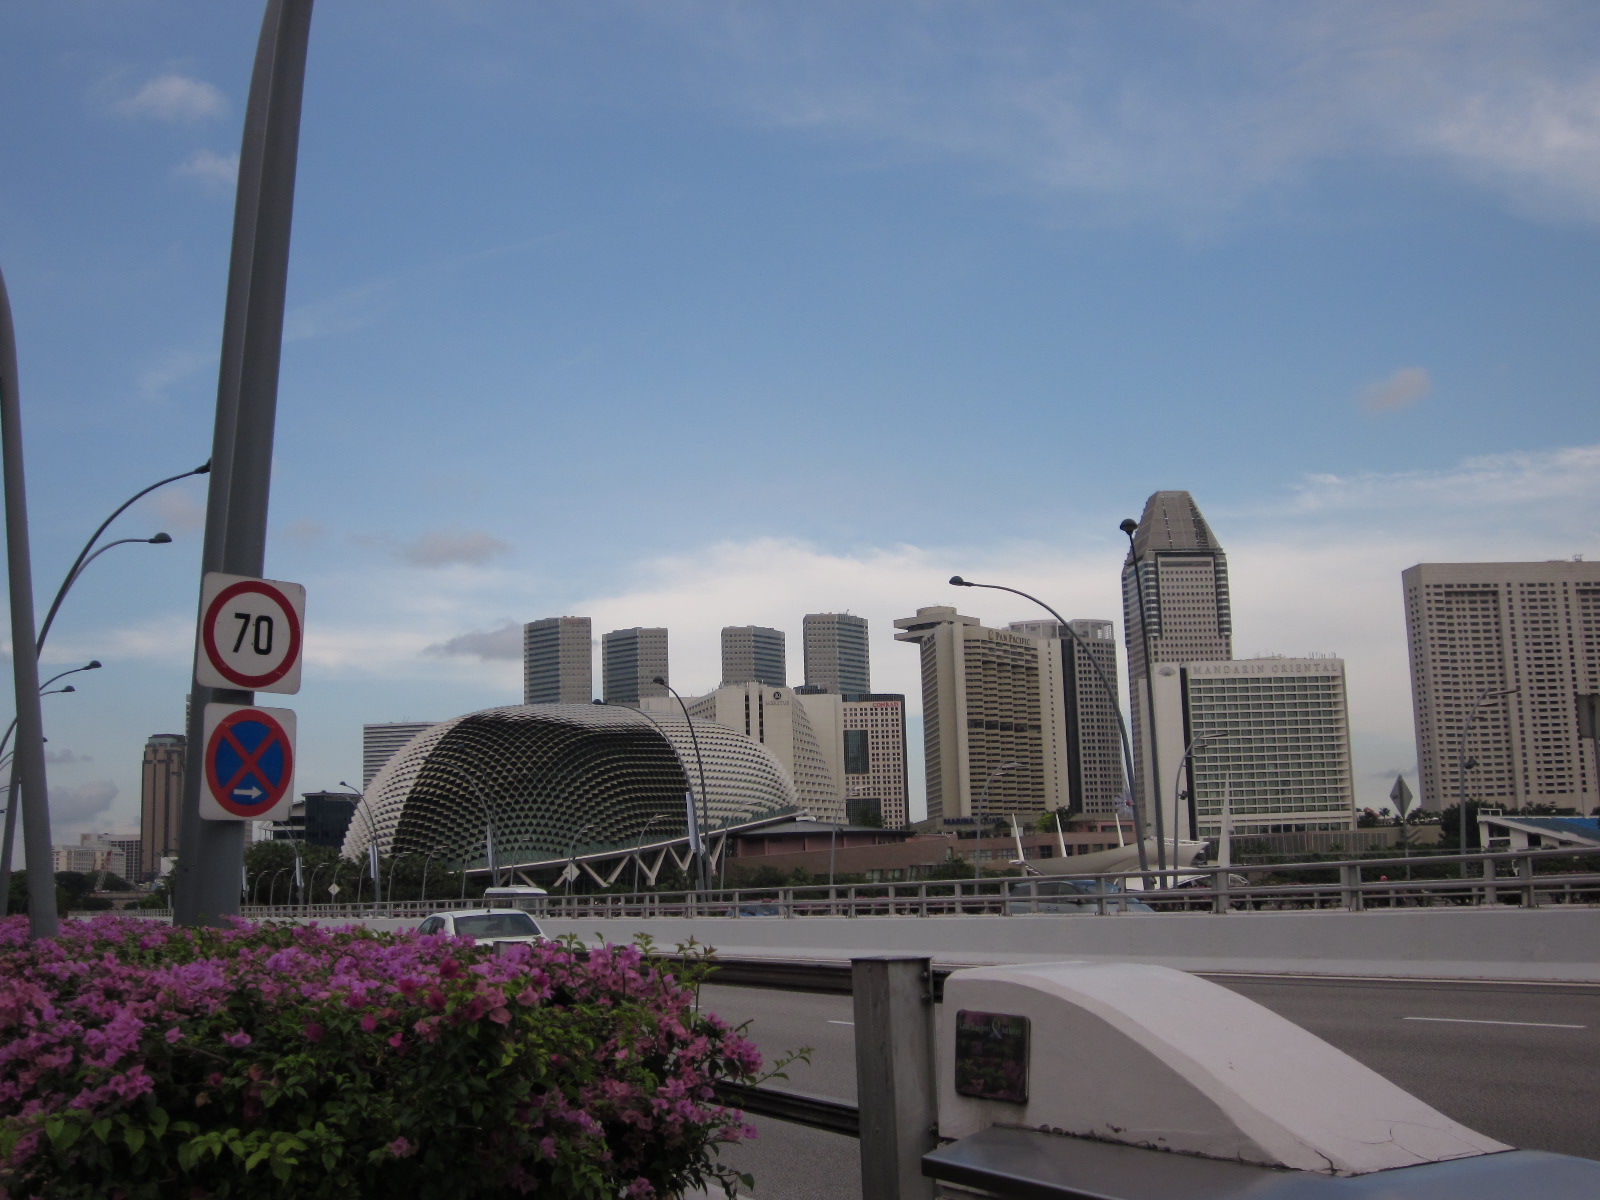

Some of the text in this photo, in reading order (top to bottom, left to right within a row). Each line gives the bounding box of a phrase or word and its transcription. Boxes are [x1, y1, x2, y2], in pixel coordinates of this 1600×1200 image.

[232, 612, 274, 656] 70
[995, 631, 1031, 646] PAN PACIFIC
[1193, 663, 1338, 675] MANDARIN ORIENTAL
[943, 817, 975, 825] MARINA
